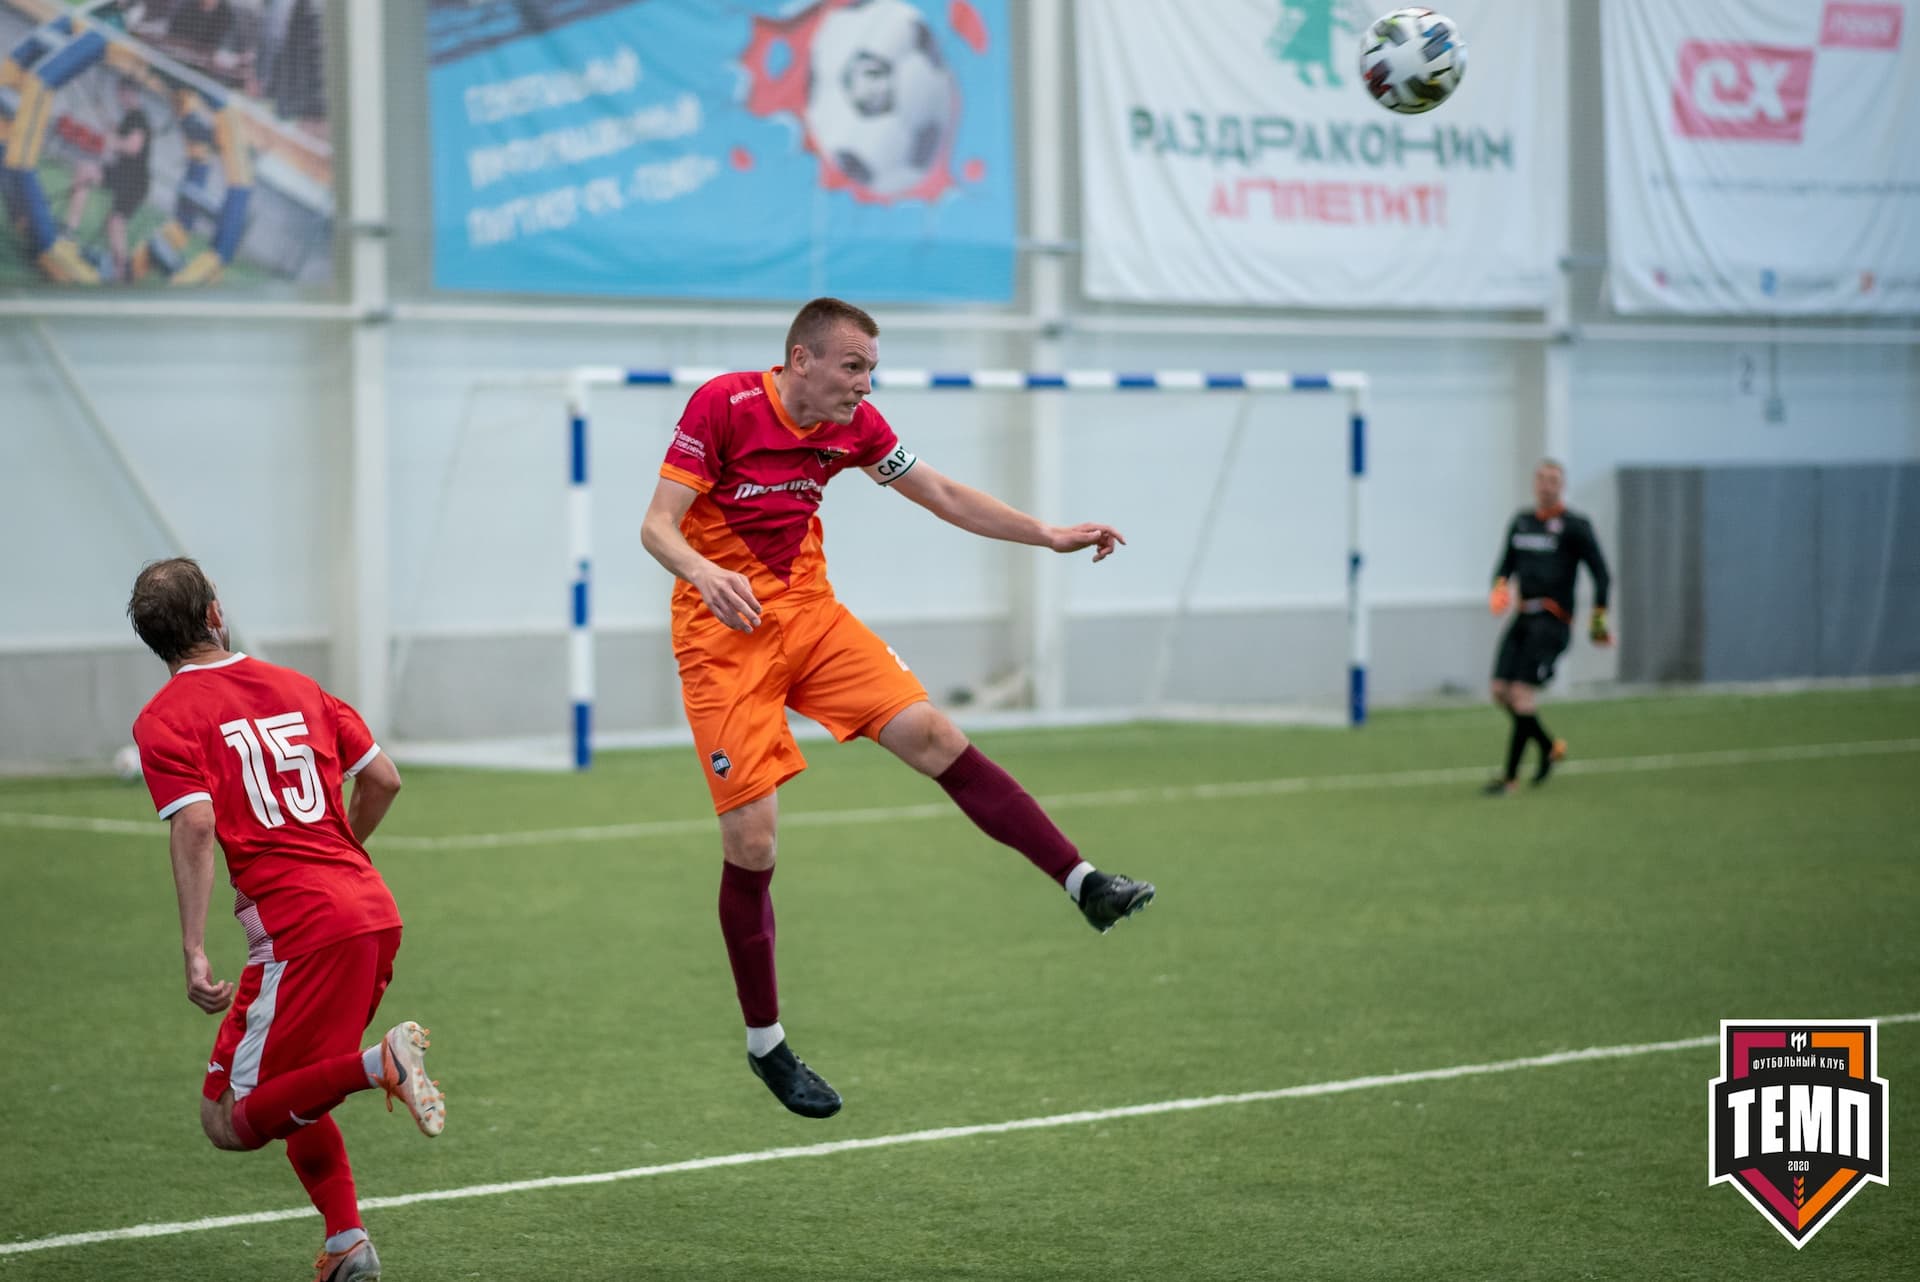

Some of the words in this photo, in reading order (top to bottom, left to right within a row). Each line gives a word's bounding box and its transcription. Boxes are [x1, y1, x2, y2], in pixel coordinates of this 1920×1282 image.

[1129, 107, 1516, 171] РАЗДРАКОНИМ
[1208, 178, 1448, 225] АППЕТИТ!
[877, 446, 907, 476] CAP
[220, 711, 327, 829] 15
